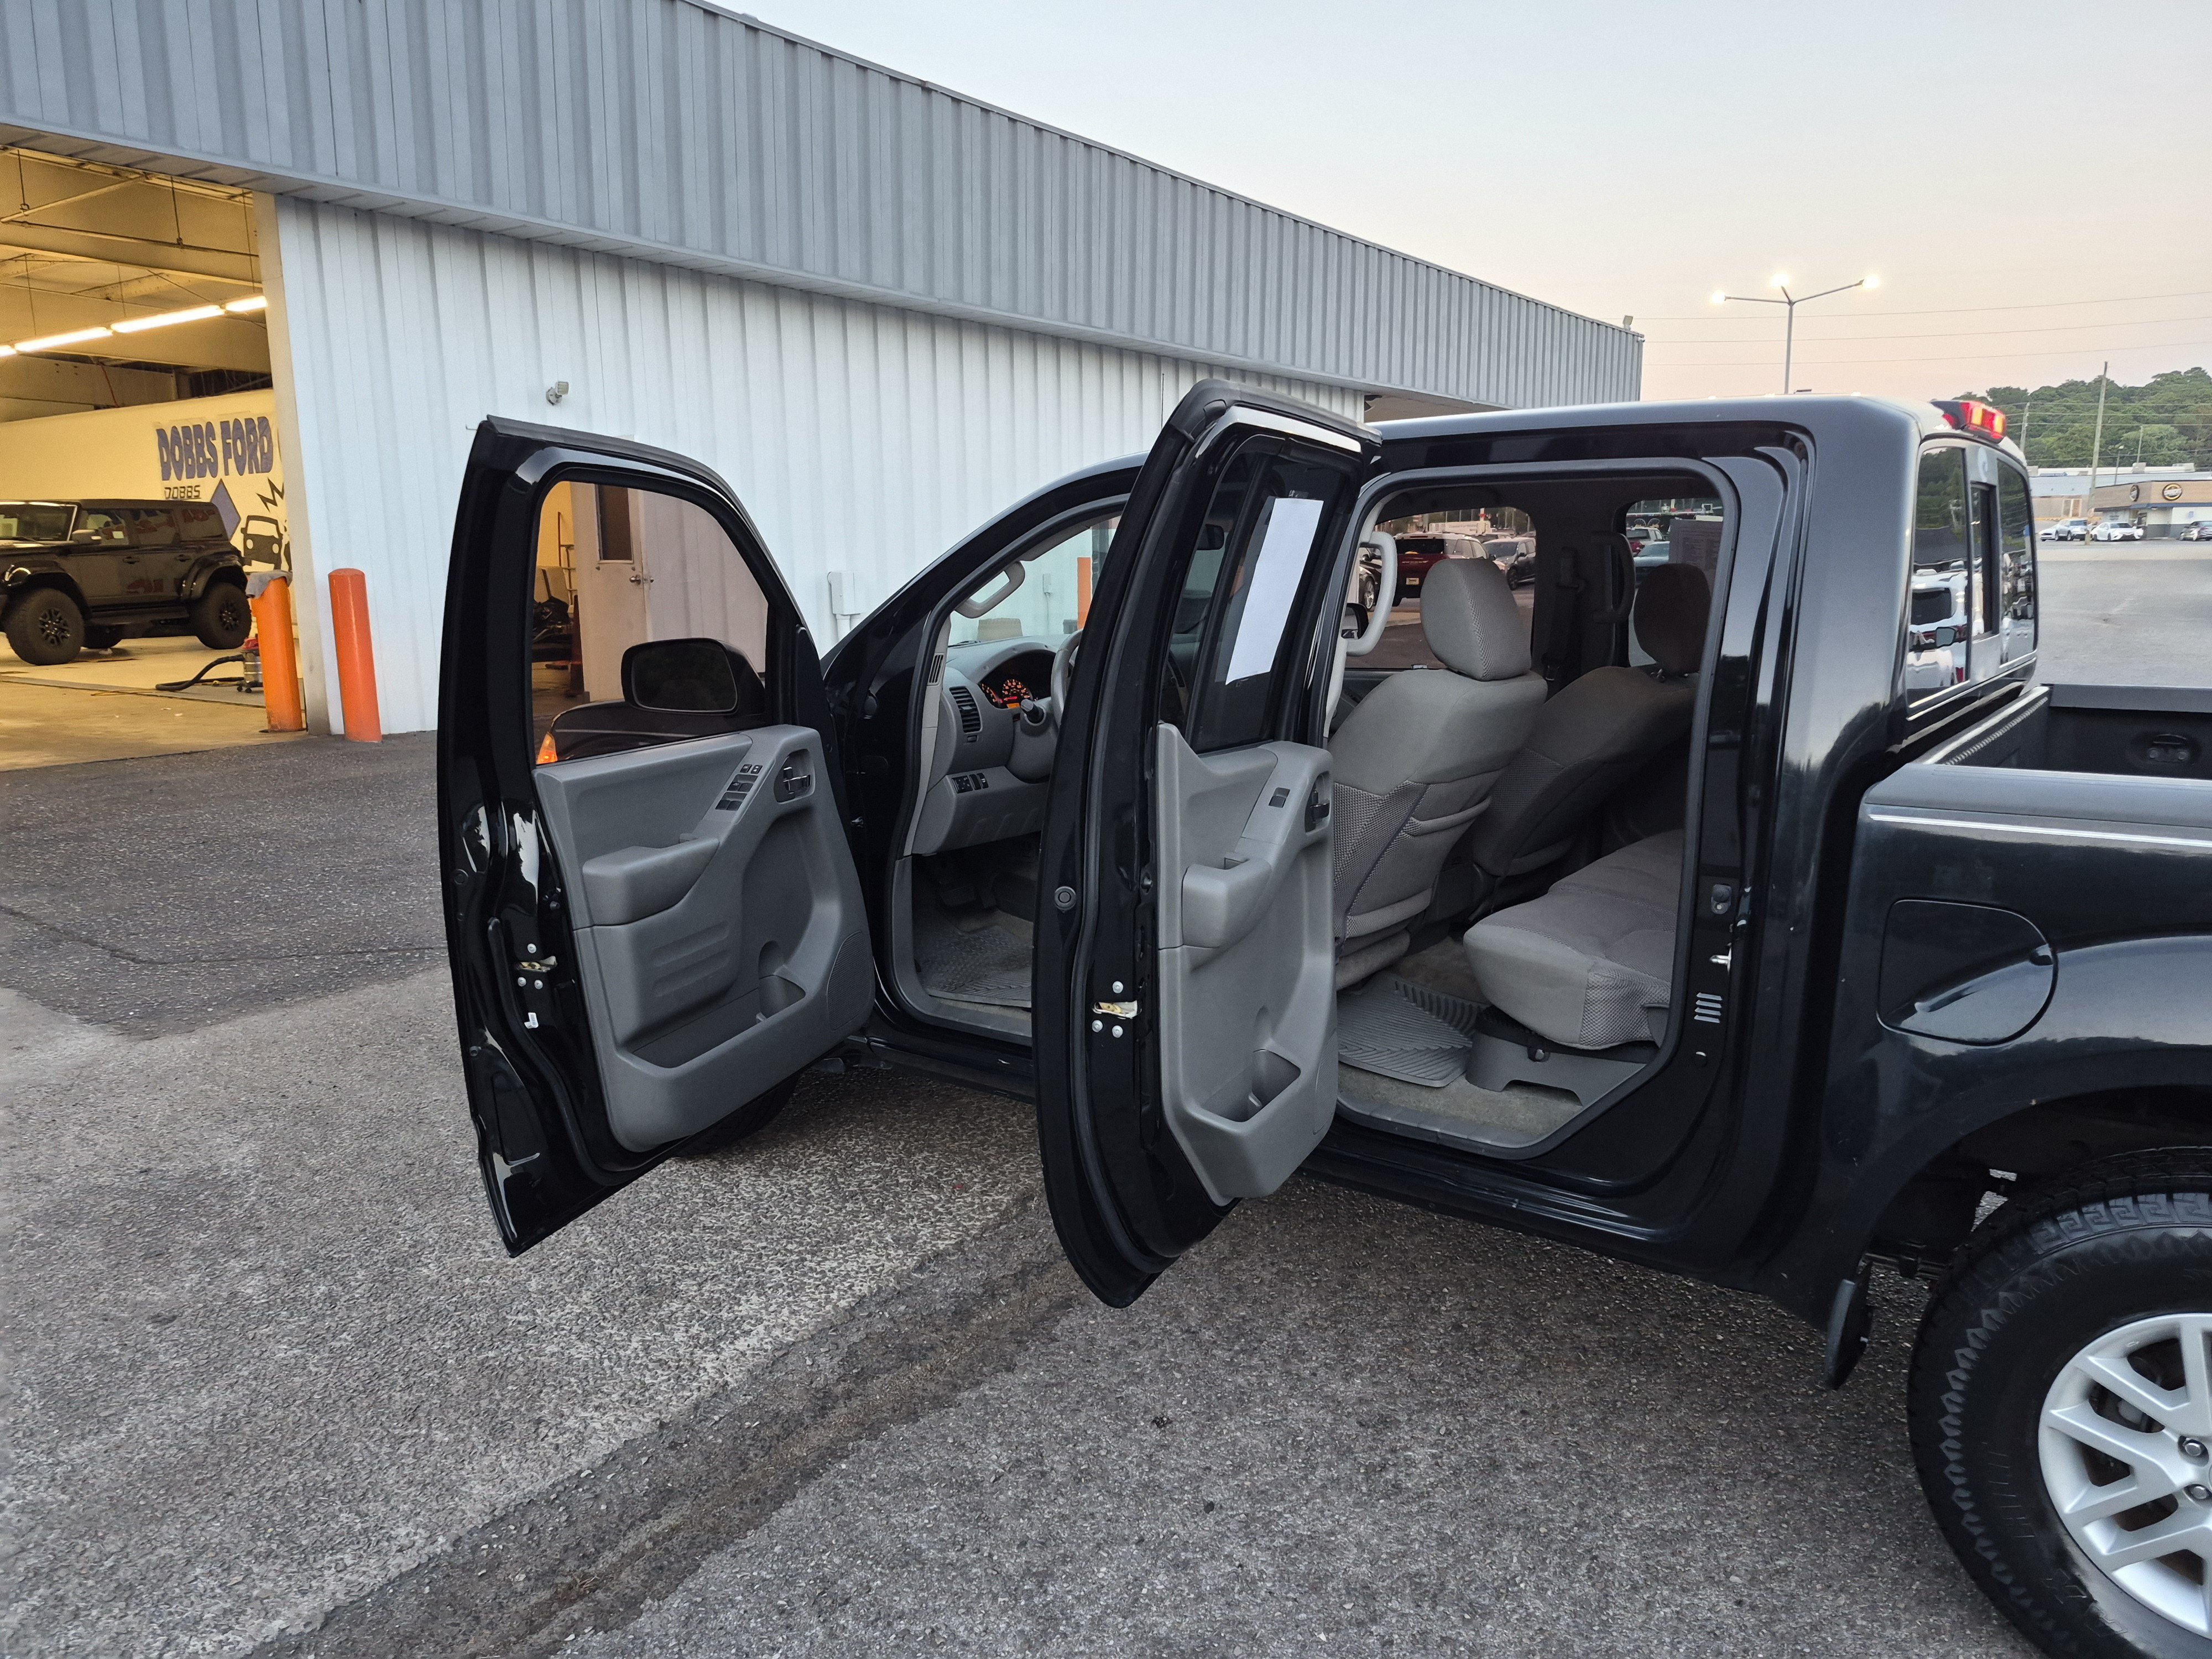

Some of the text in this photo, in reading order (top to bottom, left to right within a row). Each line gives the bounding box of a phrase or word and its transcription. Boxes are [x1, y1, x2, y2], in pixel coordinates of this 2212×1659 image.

[156, 421, 218, 481] DOBBS
[220, 416, 273, 476] FORD
[164, 484, 201, 499] DOBBS
